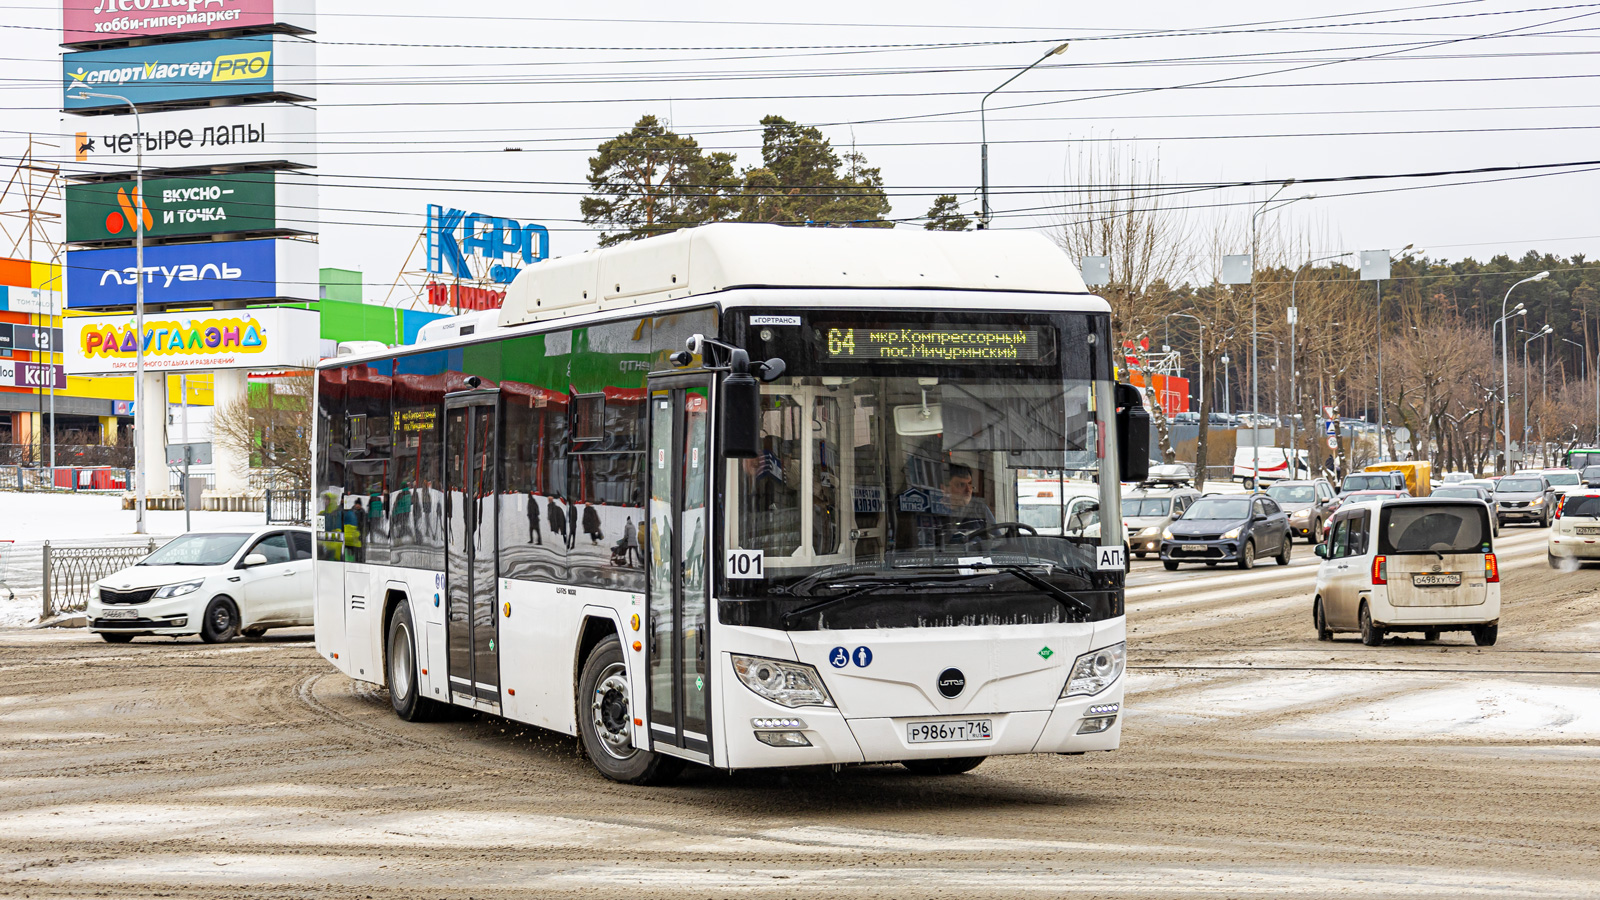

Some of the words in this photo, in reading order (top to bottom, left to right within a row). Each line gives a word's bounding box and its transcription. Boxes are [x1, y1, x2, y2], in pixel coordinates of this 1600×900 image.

[94, 8, 242, 33] хобби-гипермаркет
[214, 56, 265, 78] PRO
[104, 128, 194, 154] четыре
[200, 122, 266, 148] лапы
[163, 209, 174, 225] И
[177, 206, 227, 223] ТОЧКА
[17, 298, 31, 306] TOM
[828, 328, 855, 355] 64
[869, 329, 1027, 346] мкр.Компрессорный
[880, 343, 1017, 360] пос.Мичуринский
[128, 359, 161, 369] СЕМЙНОГО
[163, 360, 188, 368] ОТДЫХА
[190, 359, 194, 367] И
[195, 356, 235, 367] РАЗВЛЕЧЕНИЙ
[25, 364, 57, 386] kari
[729, 553, 762, 574] 101
[912, 724, 965, 740] Р986УТ
[968, 722, 989, 734] 716
